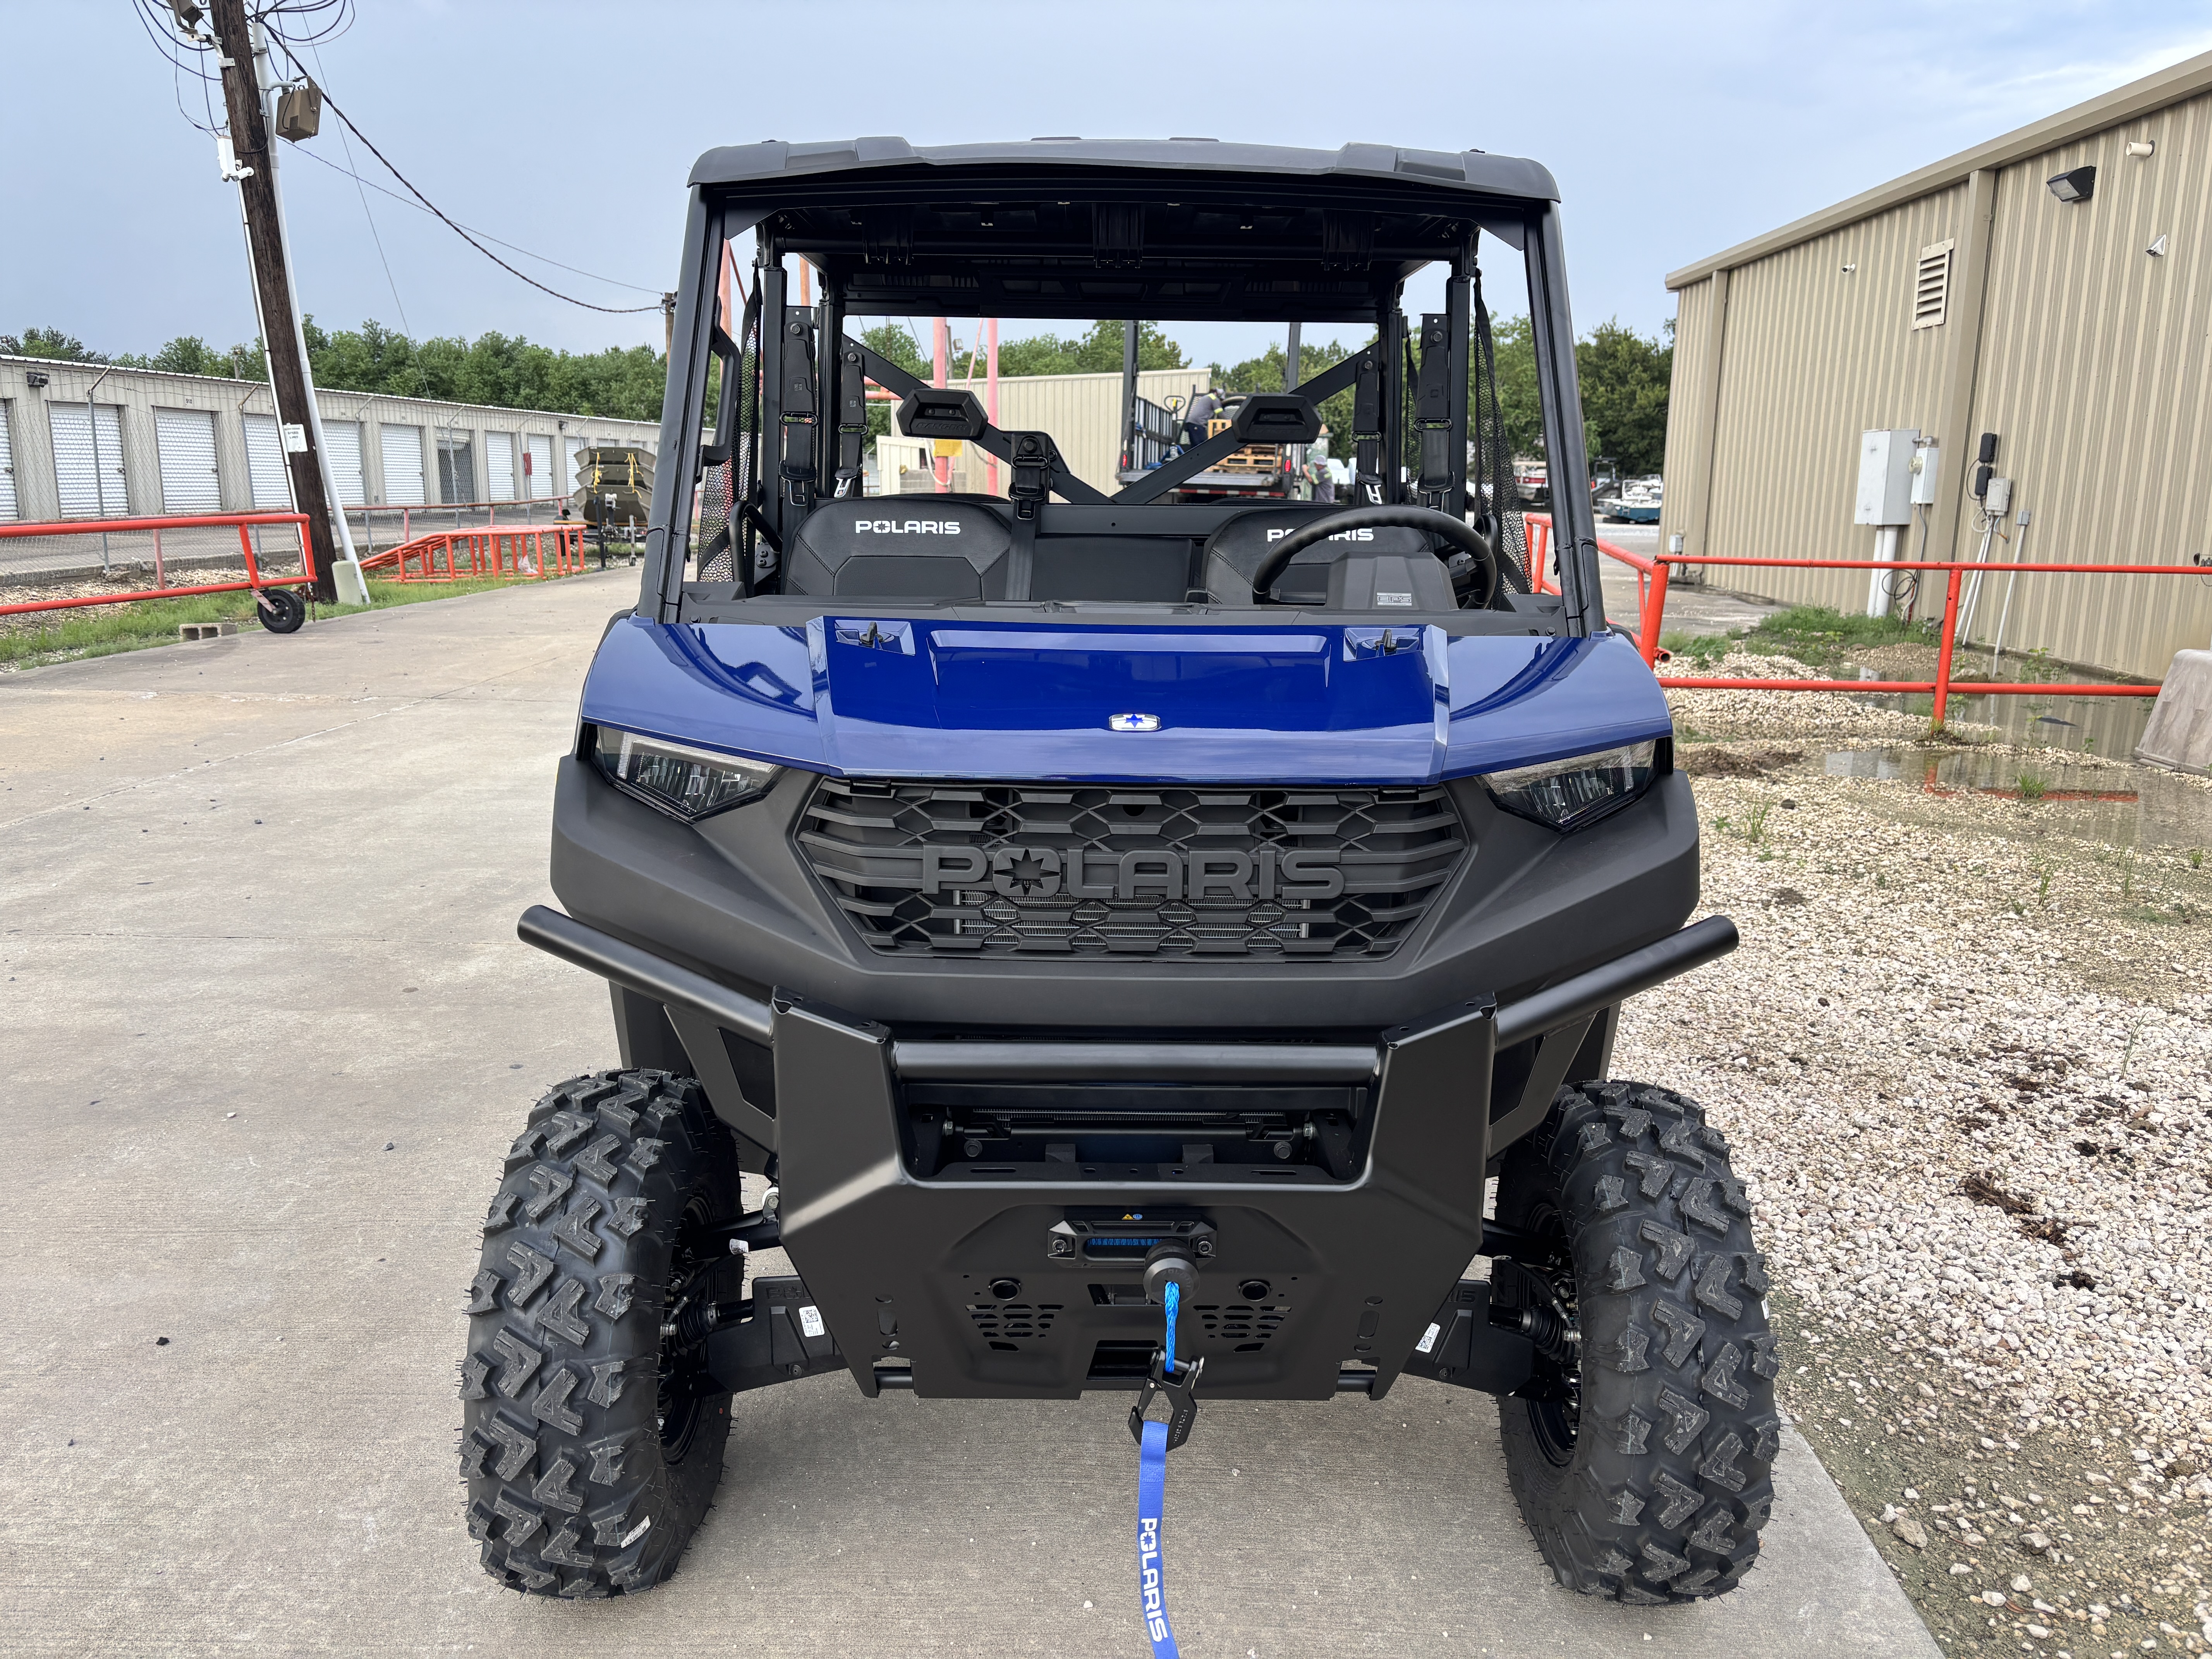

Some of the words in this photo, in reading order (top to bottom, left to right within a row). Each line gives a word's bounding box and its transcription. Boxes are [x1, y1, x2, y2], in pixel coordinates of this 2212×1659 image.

[855, 520, 961, 534] POLARIS
[1267, 528, 1374, 542] PRIS
[923, 845, 1345, 901] POLARIS
[1140, 1518, 1168, 1642] POLARIS
